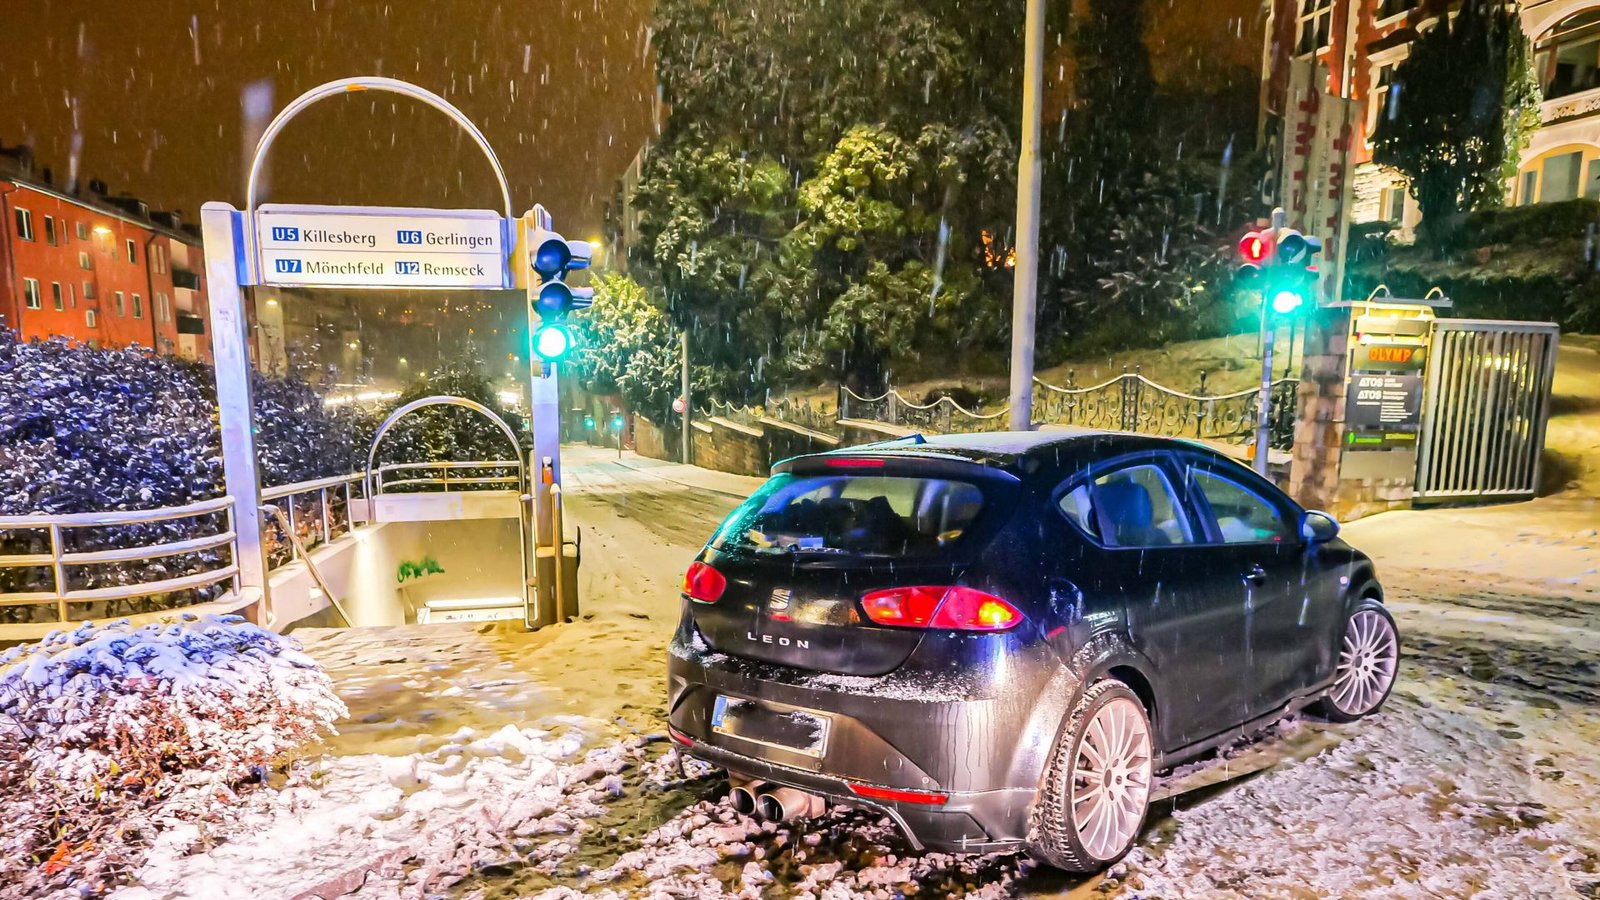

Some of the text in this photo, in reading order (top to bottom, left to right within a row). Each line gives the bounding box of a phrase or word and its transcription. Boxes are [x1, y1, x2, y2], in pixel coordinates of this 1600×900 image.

[275, 228, 376, 247] U5 Killesberg
[399, 232, 493, 249] U6 Gerlingen
[278, 260, 384, 275] U7 Mönchfeld
[395, 262, 484, 276] U12 Remseck
[1369, 347, 1412, 362] OLYMP
[1359, 378, 1384, 387] ATOS
[1357, 390, 1382, 399] ATOS
[747, 631, 809, 649] LEON
